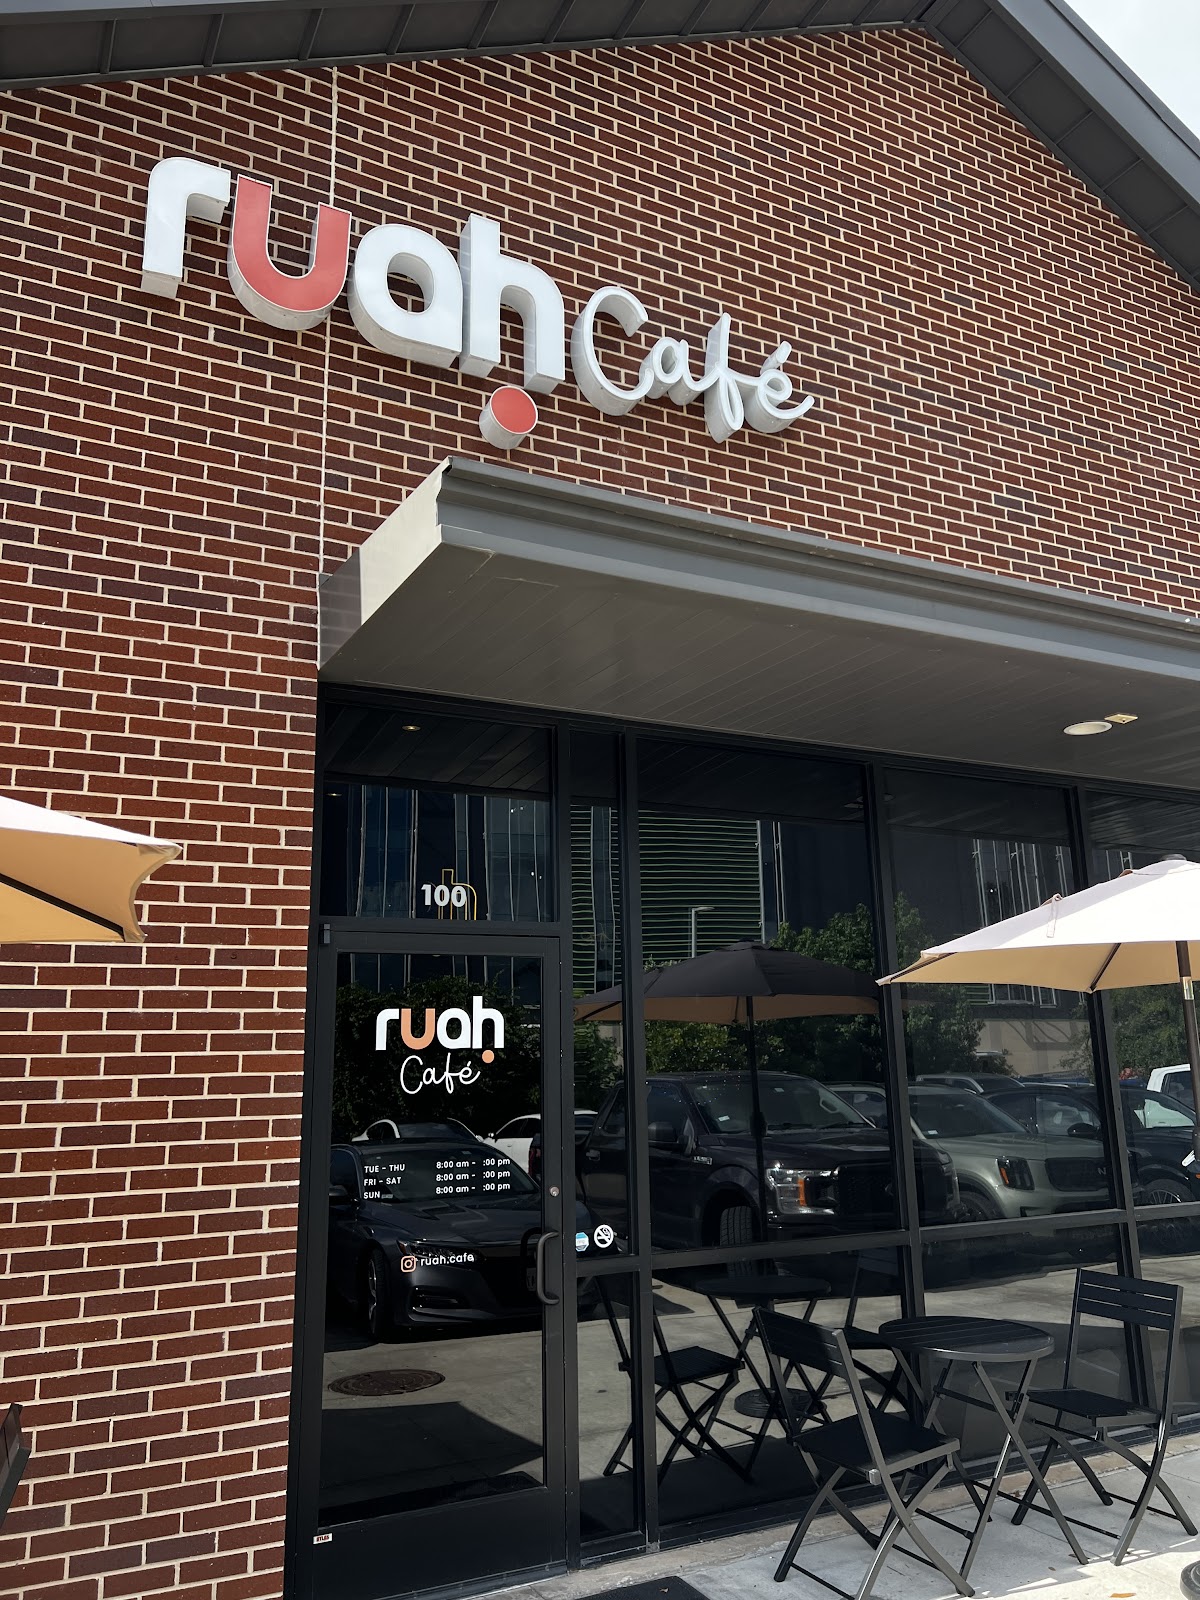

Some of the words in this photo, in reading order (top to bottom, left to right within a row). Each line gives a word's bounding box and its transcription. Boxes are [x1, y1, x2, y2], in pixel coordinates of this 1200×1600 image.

[571, 286, 814, 442] Café
[421, 884, 467, 908] 100
[400, 1053, 480, 1094] Café
[364, 1165, 379, 1174] TUE
[389, 1164, 405, 1172] THU
[436, 1161, 453, 1169] 8:00
[497, 1158, 510, 1168] pm
[364, 1179, 376, 1187] FRI
[386, 1177, 401, 1185] SAT
[436, 1173, 453, 1182] 8:00
[497, 1171, 510, 1180] pm
[363, 1191, 380, 1199] SUN
[436, 1186, 453, 1195] 8:00
[497, 1183, 510, 1192] pm
[421, 1252, 474, 1266] ruah.cafe
